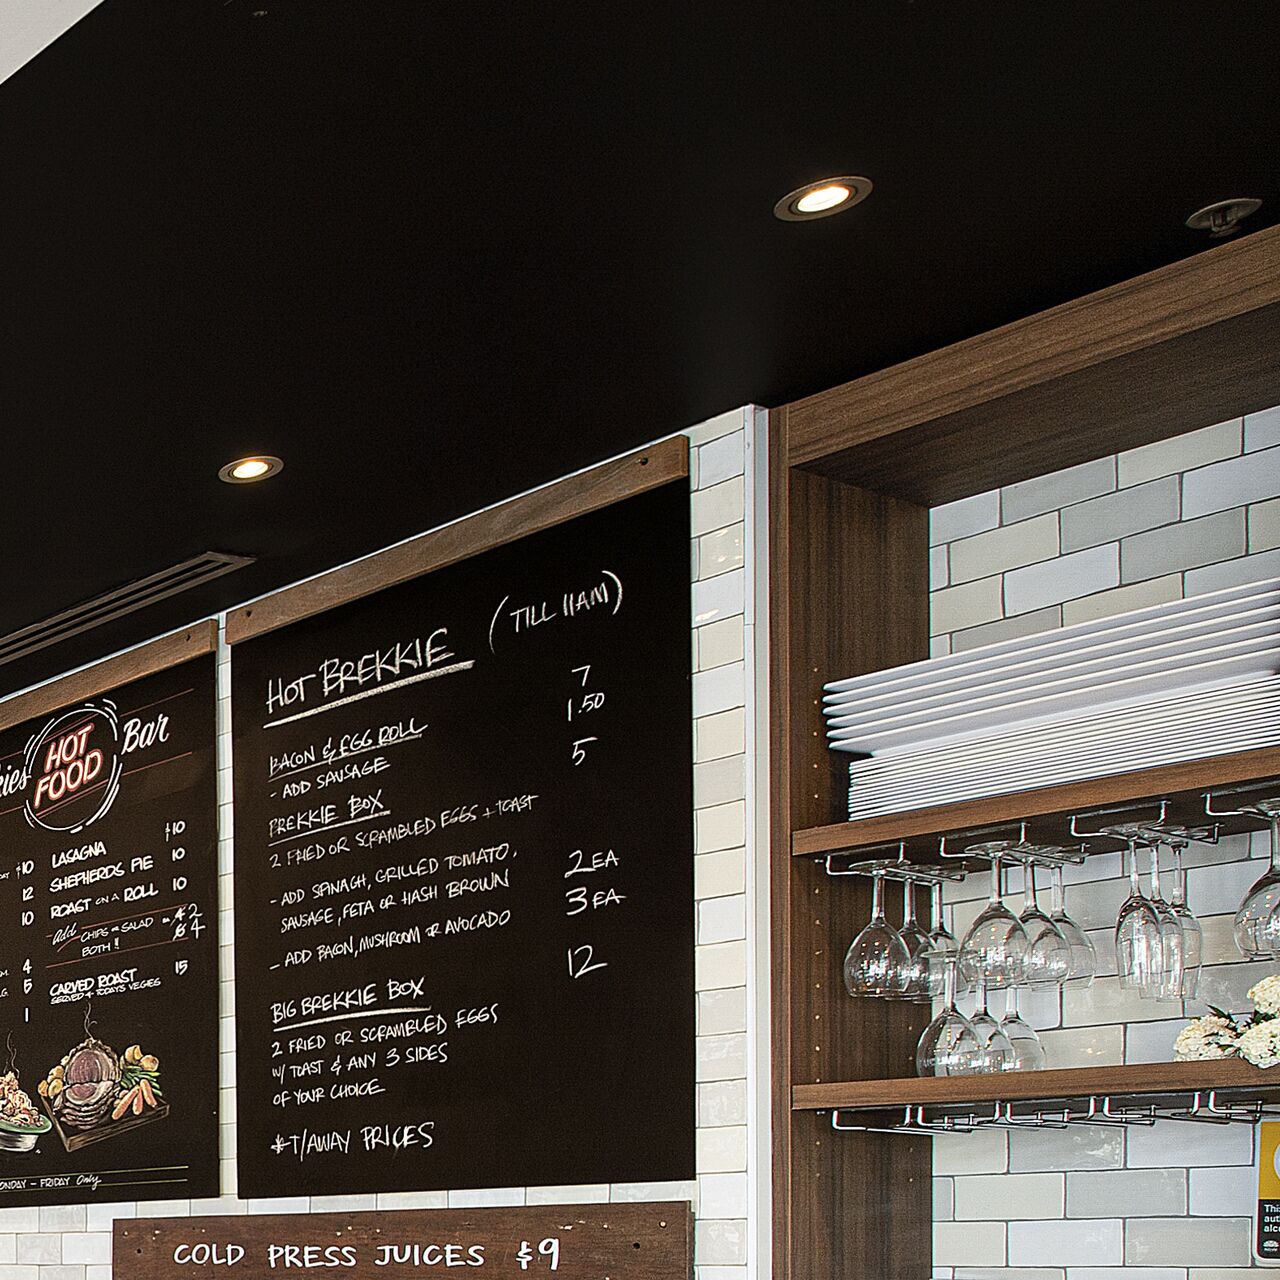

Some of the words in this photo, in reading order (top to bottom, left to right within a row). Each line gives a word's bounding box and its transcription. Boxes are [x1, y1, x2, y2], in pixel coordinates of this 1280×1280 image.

[266, 674, 316, 714] HOT
[317, 627, 454, 697] BREKKIE
[572, 665, 591, 687] 7
[566, 692, 605, 721] 1.50
[44, 722, 95, 774] HOT
[121, 713, 169, 756] Bar
[269, 747, 315, 777] BACON
[322, 742, 337, 763] &
[339, 731, 373, 756] EGG
[378, 719, 428, 746] ROLL
[572, 736, 598, 766] 5
[33, 748, 103, 809] FOOD
[282, 780, 311, 798] ADD
[316, 757, 391, 790] SAUSAGE
[269, 804, 338, 838] BREKKIE
[348, 788, 384, 811] BOX
[269, 855, 282, 869] 2
[286, 843, 326, 867] FRIED
[328, 836, 350, 856] OR
[355, 818, 437, 851] SCRAMBLED
[440, 804, 478, 829] EGGS
[495, 794, 539, 816] TOAST
[52, 841, 107, 869] LASAGNA
[172, 847, 186, 862] 10
[49, 862, 125, 893] SHEPHERDS
[131, 855, 154, 873] PIE
[172, 876, 188, 892] 10
[282, 887, 305, 906] ADD
[375, 857, 439, 883] GRILLED
[22, 886, 34, 901] 12
[50, 898, 92, 919] ROAST
[123, 883, 159, 902] ROLL
[380, 894, 396, 911] OR
[399, 883, 438, 907] HASH
[444, 869, 509, 898] BROWN
[21, 911, 35, 926] 10
[188, 903, 203, 919] 2
[80, 926, 109, 943] CHIPS
[120, 917, 154, 933] SALAD
[190, 917, 206, 940] 4
[284, 948, 312, 967] ADD
[359, 926, 421, 954] MUSHROOM
[425, 922, 442, 939] OR
[444, 910, 511, 936] AVOCADO
[22, 958, 33, 975] 4
[175, 959, 189, 976] 15
[567, 944, 608, 979] 12
[23, 978, 33, 995] 5
[49, 977, 95, 997] CARVED
[98, 968, 137, 988] ROAST
[129, 977, 162, 990] VEGIES
[271, 1000, 297, 1024] BIG
[301, 983, 378, 1015] BREKKIE
[387, 977, 425, 999] BOX
[272, 1042, 283, 1059] 2
[288, 1033, 326, 1054] FRIED
[334, 1029, 354, 1046] OR
[359, 1013, 448, 1043] SCRAMBLED
[455, 1003, 499, 1031] EGGS
[289, 1058, 324, 1078] TOAST
[331, 1053, 342, 1075] &
[346, 1052, 377, 1071] ANY
[385, 1050, 401, 1069] 3
[405, 1042, 449, 1064] SIDES
[272, 1090, 292, 1107] OF
[294, 1086, 326, 1106] YOUR
[329, 1078, 386, 1099] CHOICE
[359, 1121, 435, 1152] PRICES
[40, 1176, 70, 1188] FRIDAY
[76, 1174, 102, 1191] Only
[173, 1243, 246, 1267] COLD
[267, 1244, 357, 1269] PRESS
[373, 1244, 486, 1268] JUICES
[515, 1237, 561, 1271] $9
